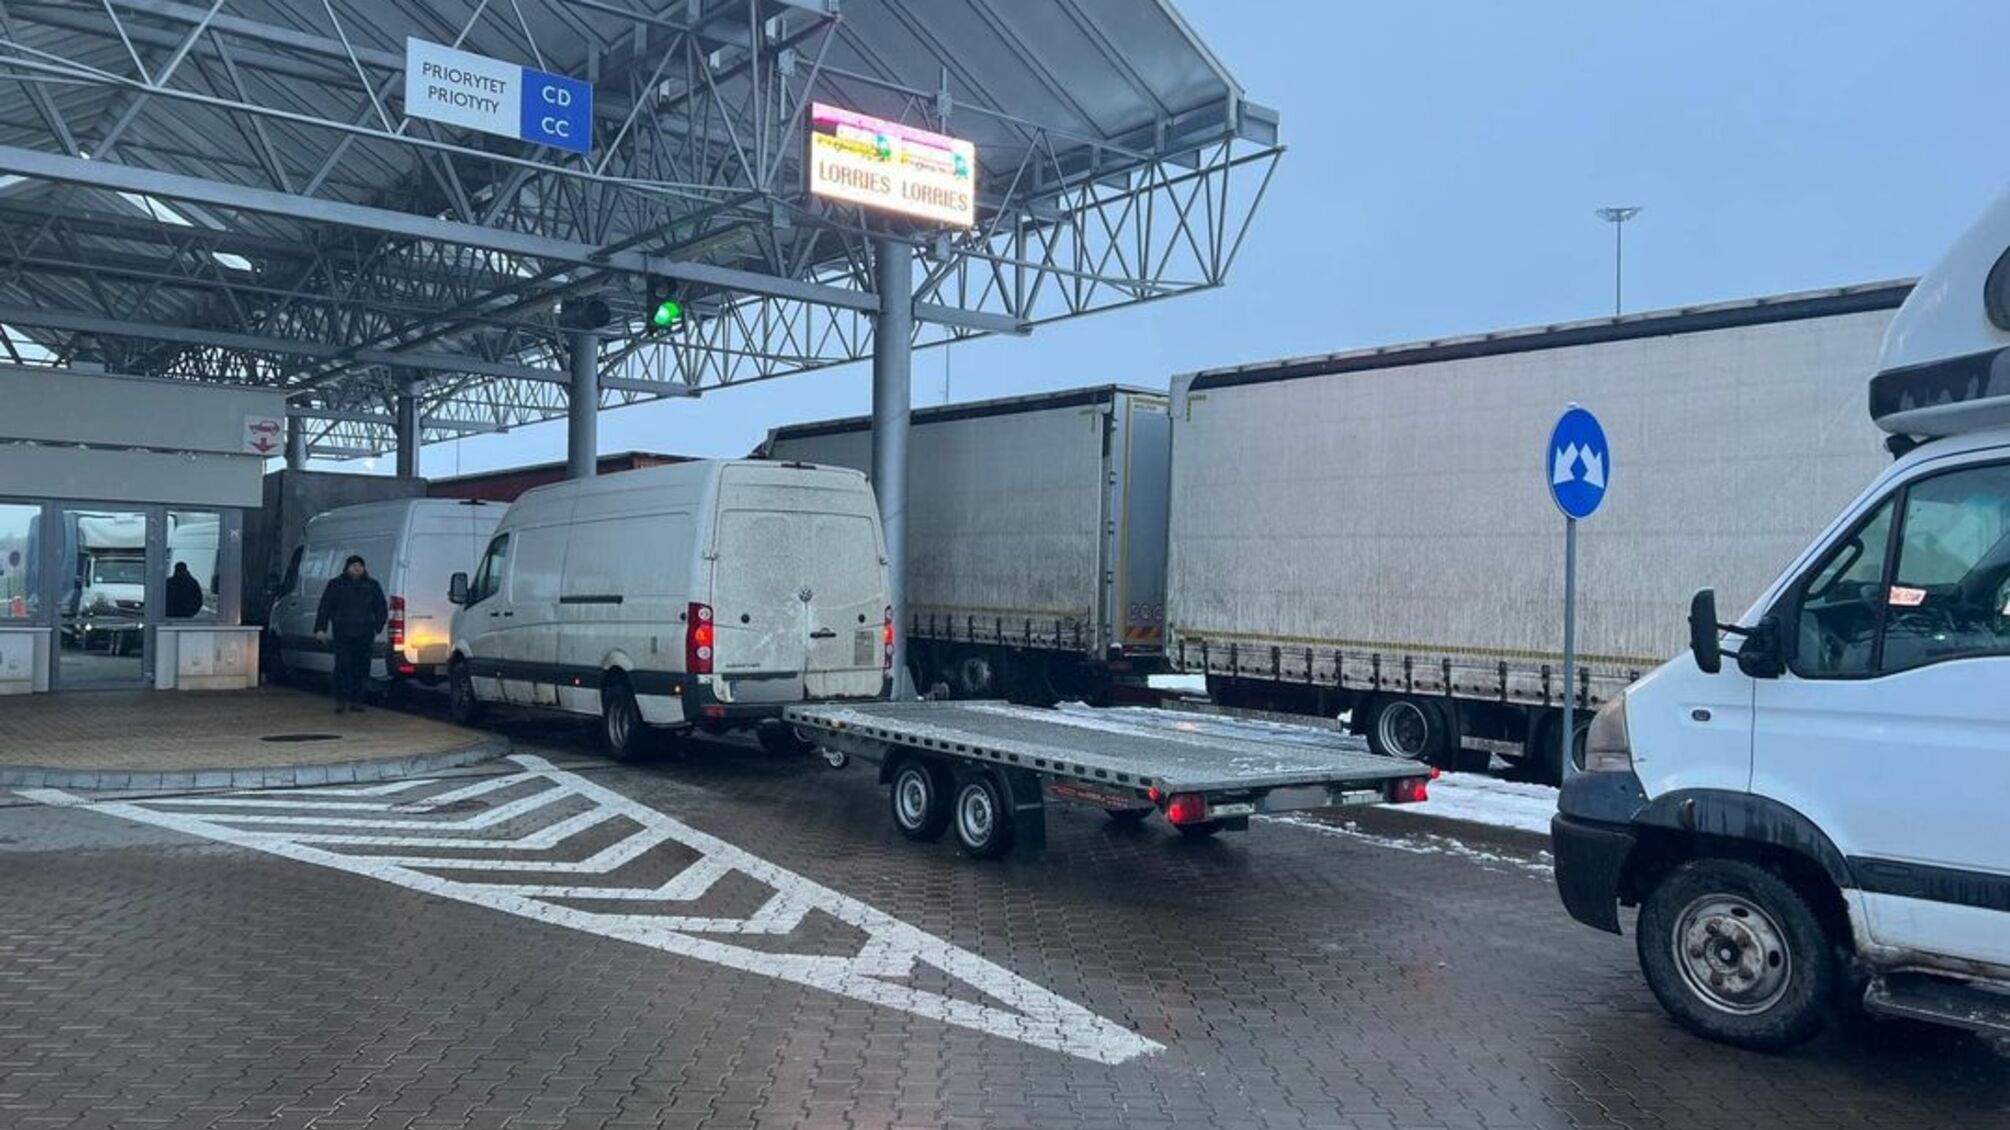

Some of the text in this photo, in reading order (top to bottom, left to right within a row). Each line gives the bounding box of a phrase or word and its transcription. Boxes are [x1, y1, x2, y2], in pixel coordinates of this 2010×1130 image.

[422, 62, 507, 94] PRIORYTET
[428, 85, 500, 114] PRIOTYTY
[541, 85, 571, 107] CD
[541, 116, 569, 137] CC
[819, 160, 891, 193] LORRIES
[902, 179, 968, 212] LORRIES
